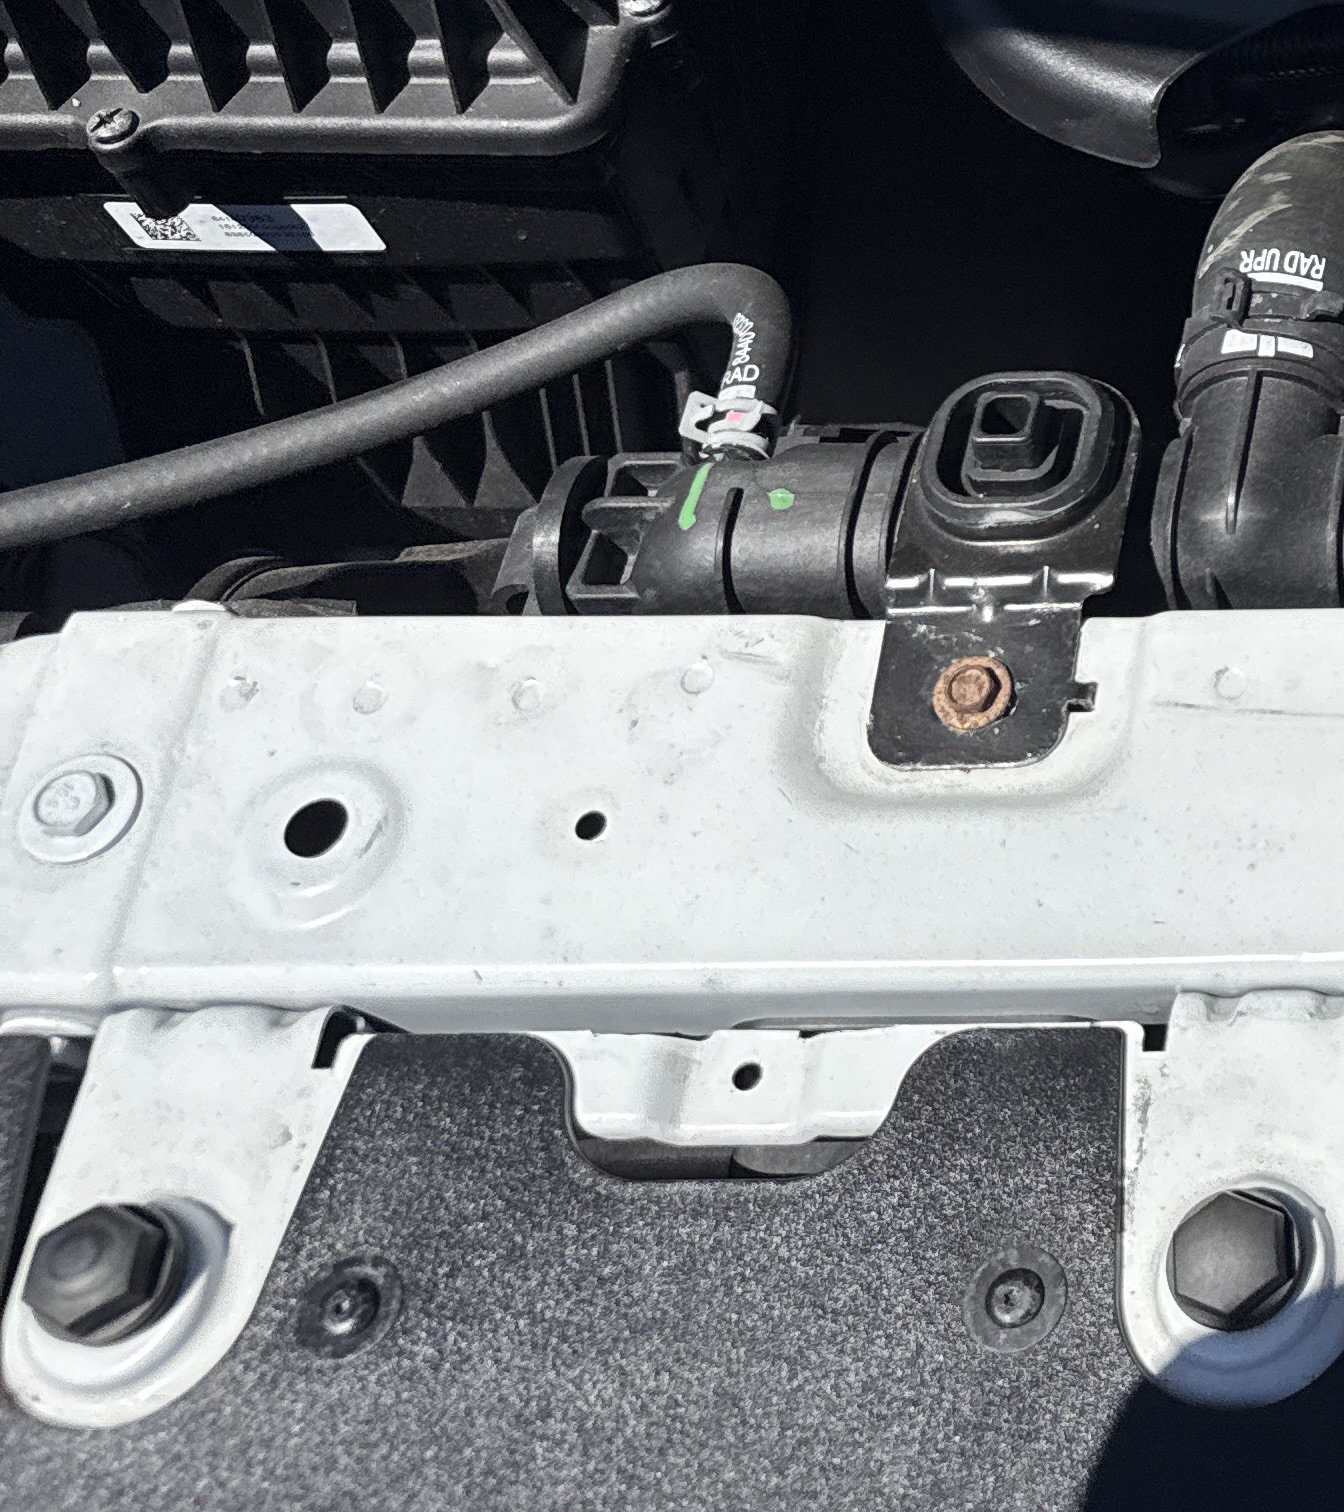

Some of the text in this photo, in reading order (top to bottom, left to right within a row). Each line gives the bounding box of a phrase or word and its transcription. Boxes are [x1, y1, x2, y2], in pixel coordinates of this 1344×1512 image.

[1239, 248, 1327, 280] RAD UPR
[723, 364, 760, 386] RAD
